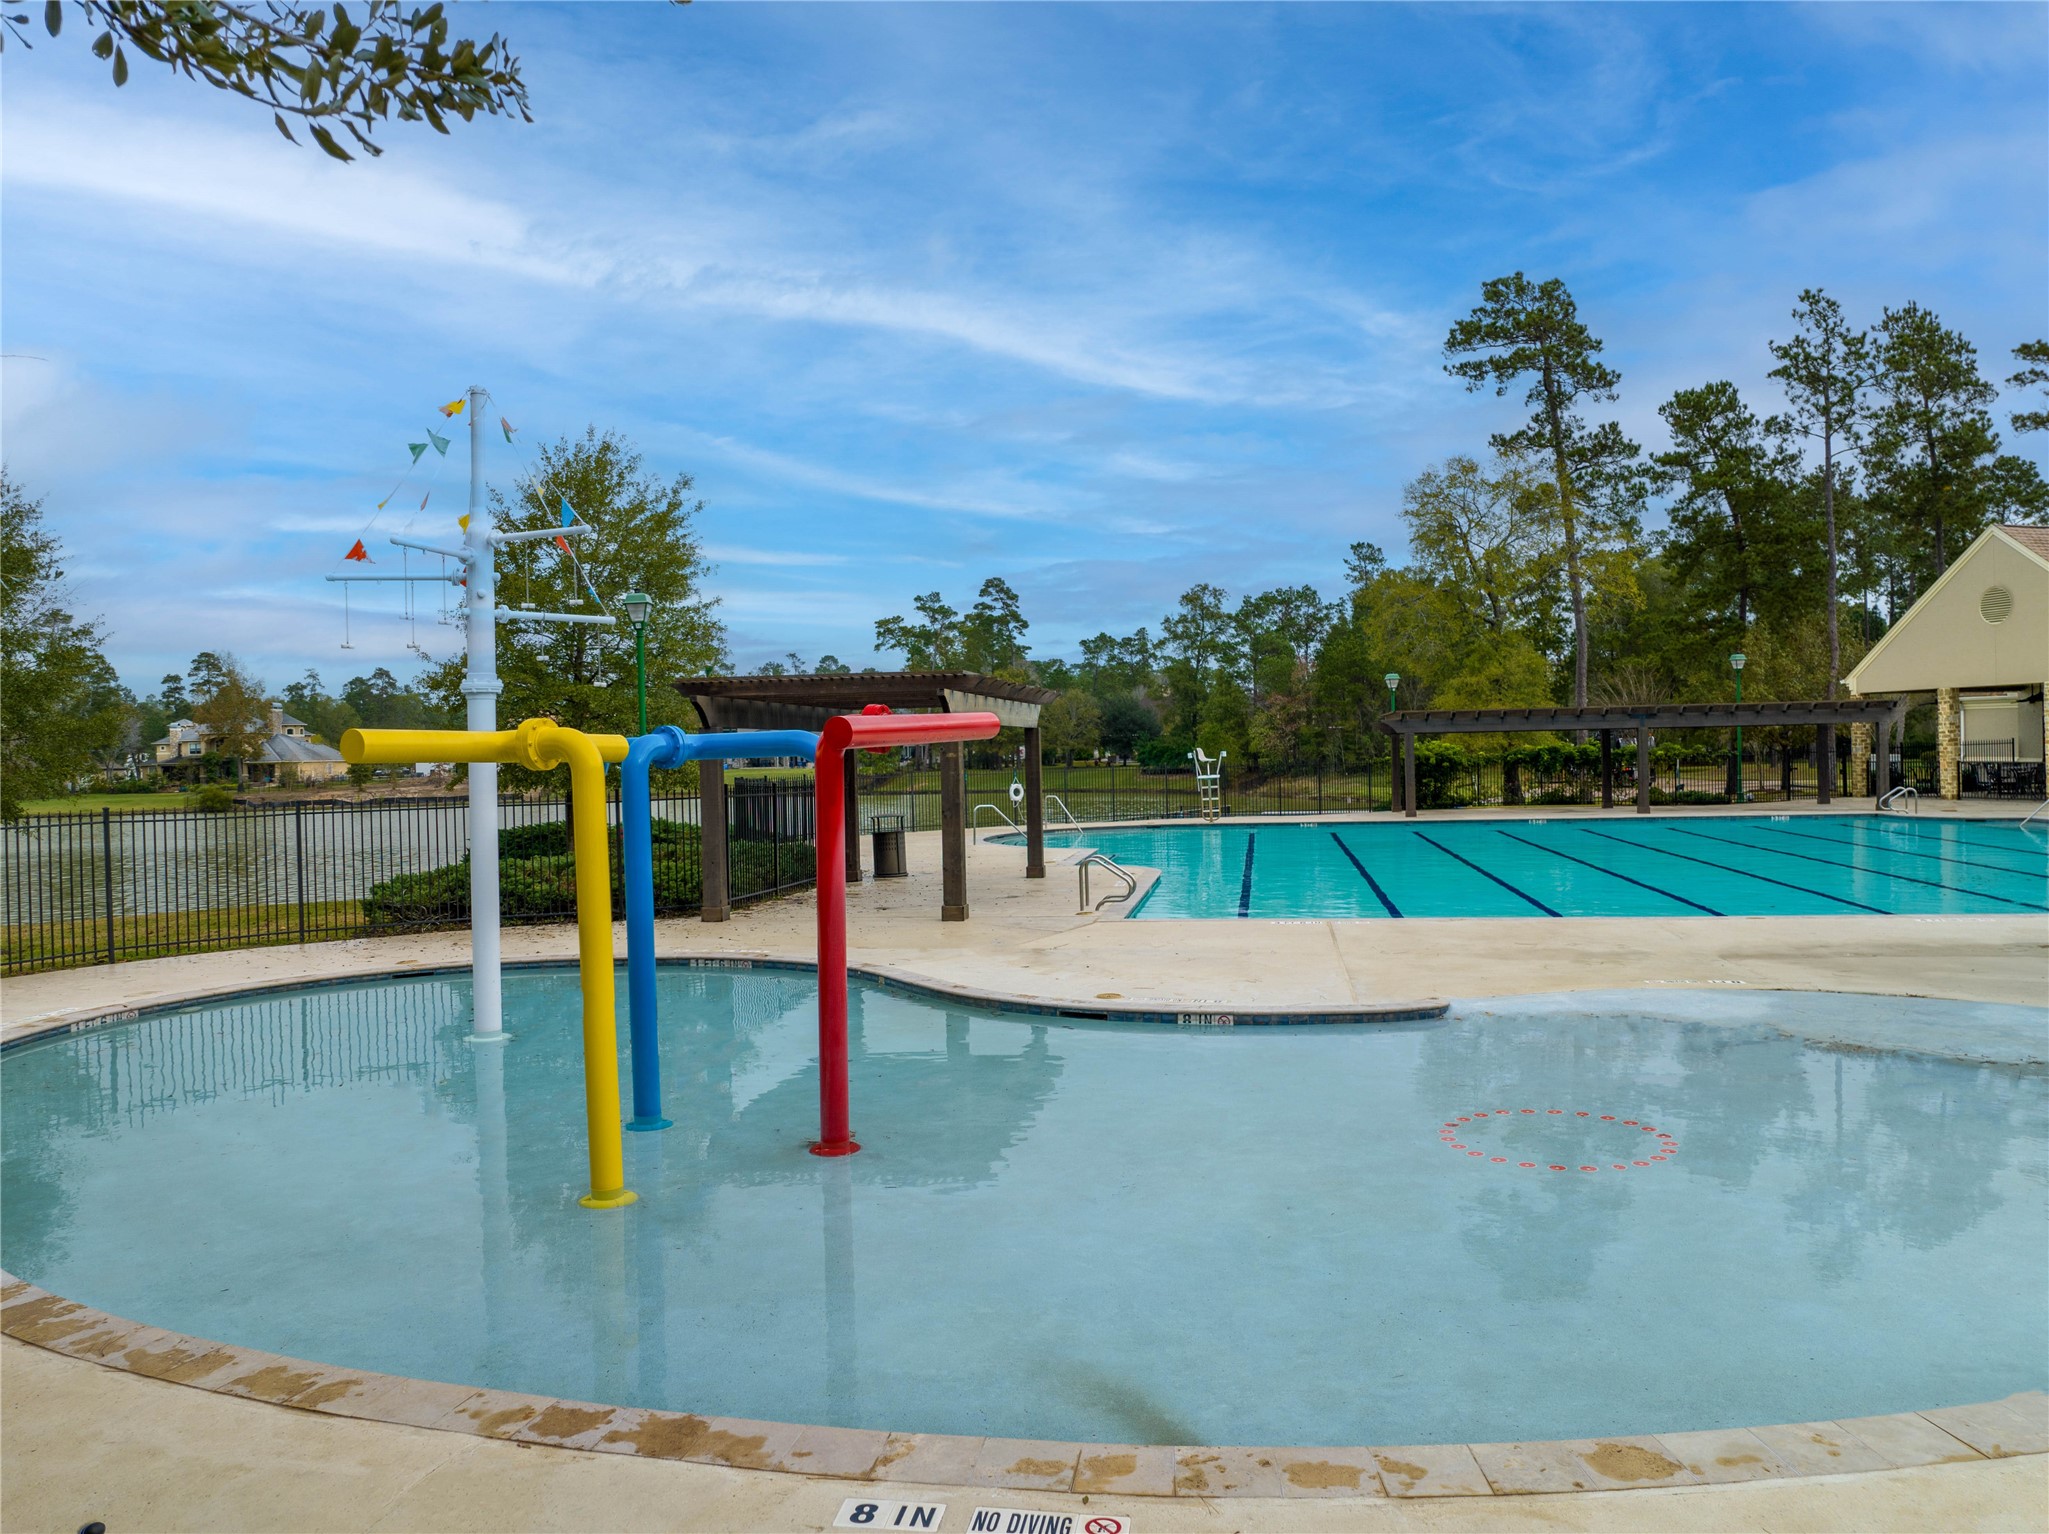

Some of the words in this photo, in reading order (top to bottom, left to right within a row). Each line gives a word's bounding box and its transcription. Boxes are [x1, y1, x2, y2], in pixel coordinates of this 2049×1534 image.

[1199, 1014, 1212, 1025] IN
[849, 1503, 879, 1524] 8
[893, 1505, 937, 1528] IN
[971, 1511, 1002, 1533] NO
[1006, 1513, 1074, 1534] DIVING
